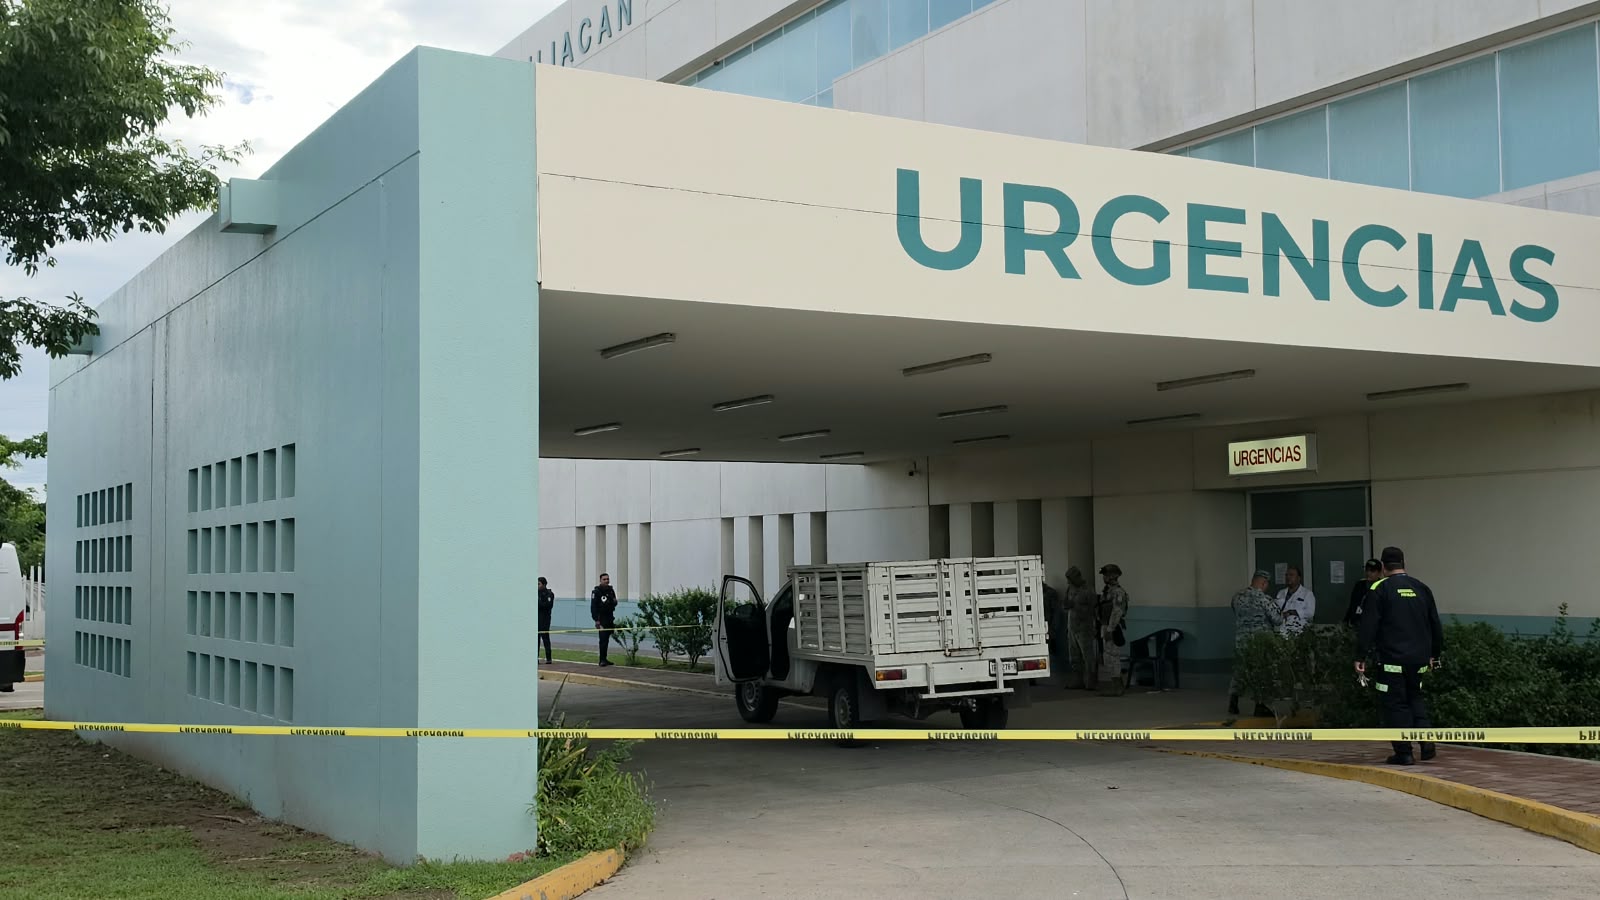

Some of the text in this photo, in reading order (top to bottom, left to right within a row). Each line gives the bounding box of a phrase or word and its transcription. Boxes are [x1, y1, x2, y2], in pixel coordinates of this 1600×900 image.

[528, 0, 632, 67] IACAN
[896, 168, 1559, 323] URGENCIAS
[1233, 445, 1301, 467] URGENCIAS
